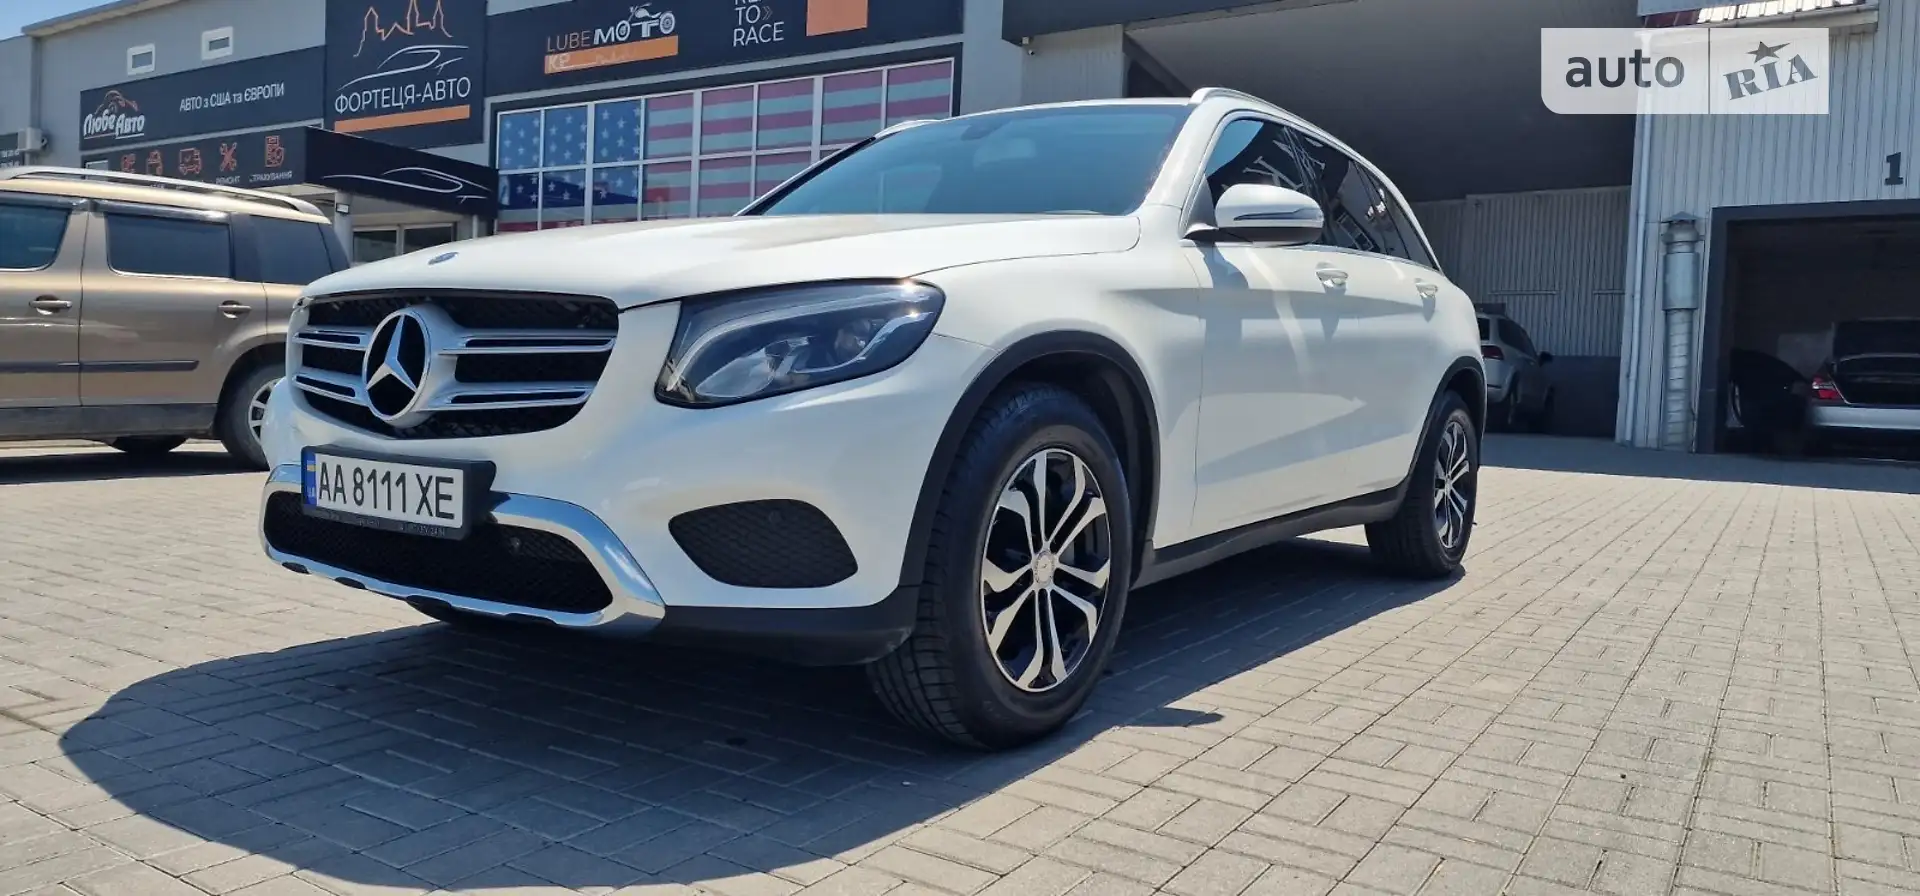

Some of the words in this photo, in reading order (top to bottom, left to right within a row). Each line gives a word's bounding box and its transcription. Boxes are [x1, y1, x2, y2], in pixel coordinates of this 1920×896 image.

[734, 5, 761, 25] TO
[733, 21, 785, 47] RACE
[180, 97, 202, 112] АВТО
[209, 93, 231, 108] США
[244, 82, 285, 102] ЄВРОПИ
[334, 76, 471, 114] ФОРТЕЦЯ-АВТО
[1884, 151, 1904, 185] 1
[319, 462, 347, 504] AA
[353, 467, 407, 513] 8111
[415, 473, 455, 520] XE
